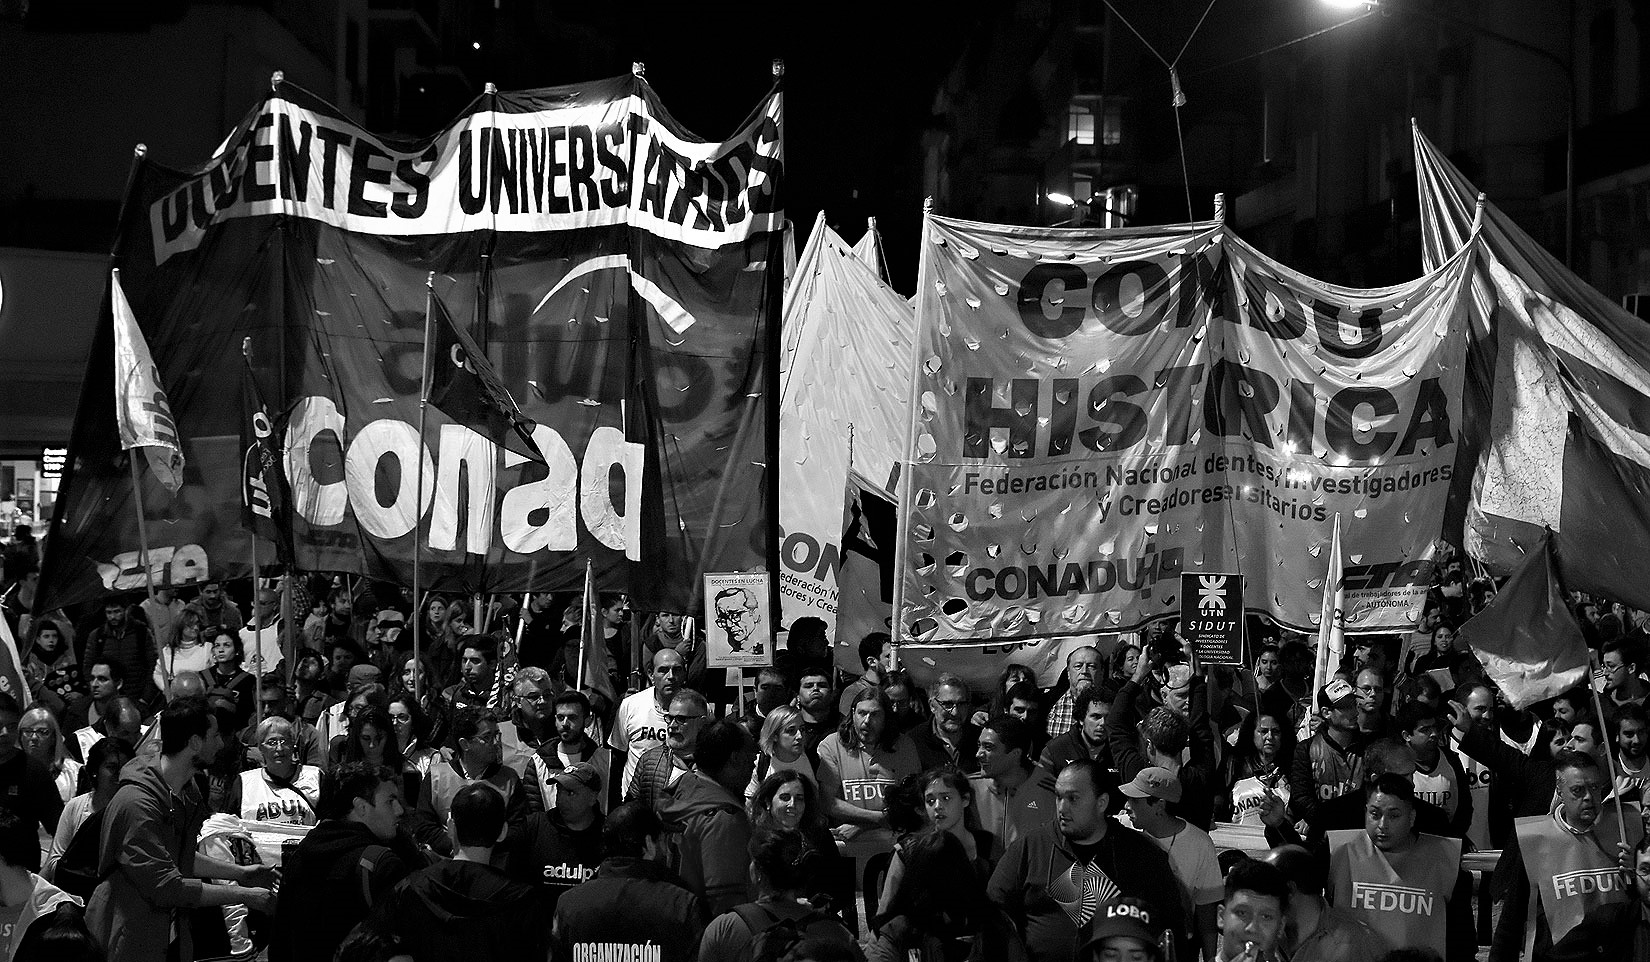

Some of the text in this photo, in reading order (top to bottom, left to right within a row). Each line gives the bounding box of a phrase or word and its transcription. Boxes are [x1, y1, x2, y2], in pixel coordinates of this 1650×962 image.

[965, 465, 1097, 495] Federación
[1106, 456, 1197, 486] Nacional
[1119, 485, 1223, 517] Creadores
[779, 570, 828, 597] ederación
[1361, 589, 1401, 599] trabajadores
[1403, 588, 1411, 597] de
[1413, 588, 1419, 596] la
[1201, 609, 1224, 617] UTN
[1366, 599, 1410, 609] AUTÓNOMA
[1188, 620, 1236, 632] SIDUT
[1351, 881, 1434, 917] FEDUN
[1107, 903, 1150, 924] LOBO
[572, 939, 661, 962] ORGANIZACIÓN
